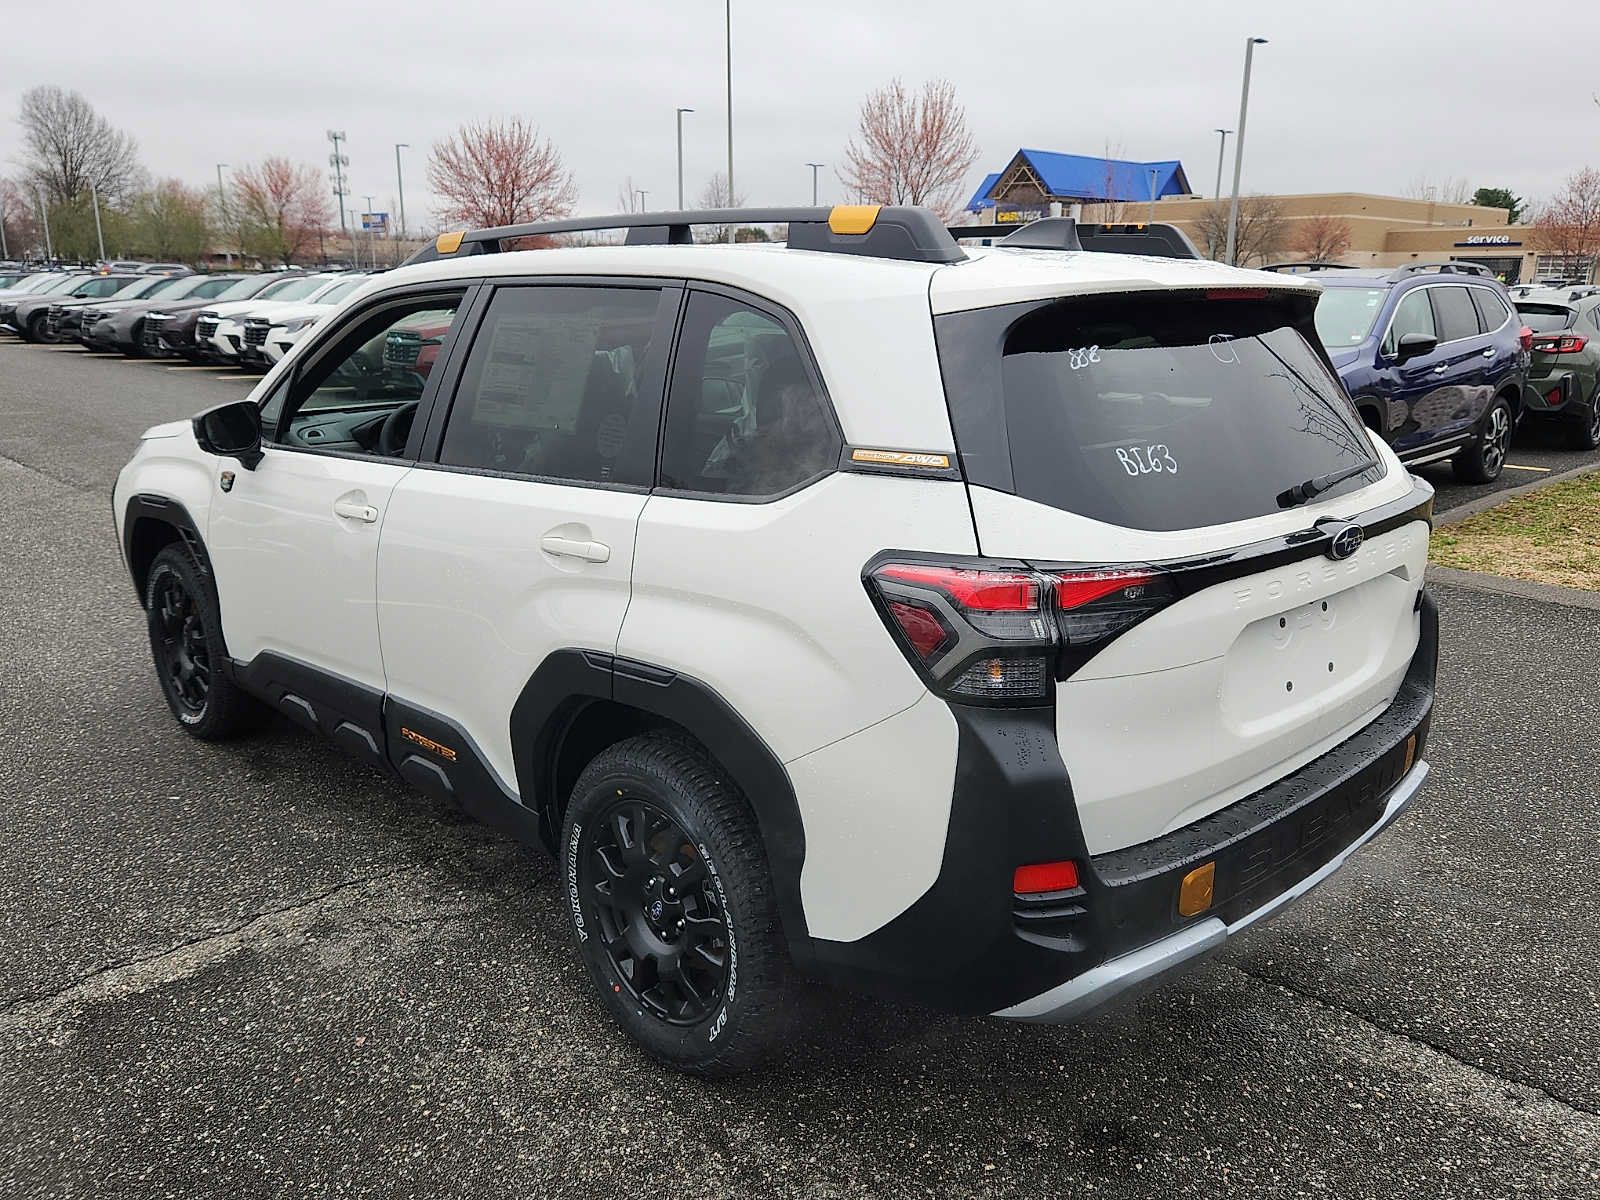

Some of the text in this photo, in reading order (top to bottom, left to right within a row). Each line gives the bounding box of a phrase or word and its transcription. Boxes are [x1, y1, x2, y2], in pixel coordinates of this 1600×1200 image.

[1467, 234, 1510, 244] service
[1233, 535, 1413, 610] FORESTER
[401, 727, 457, 761] FORESTER
[567, 823, 588, 942] YOKOHAMA
